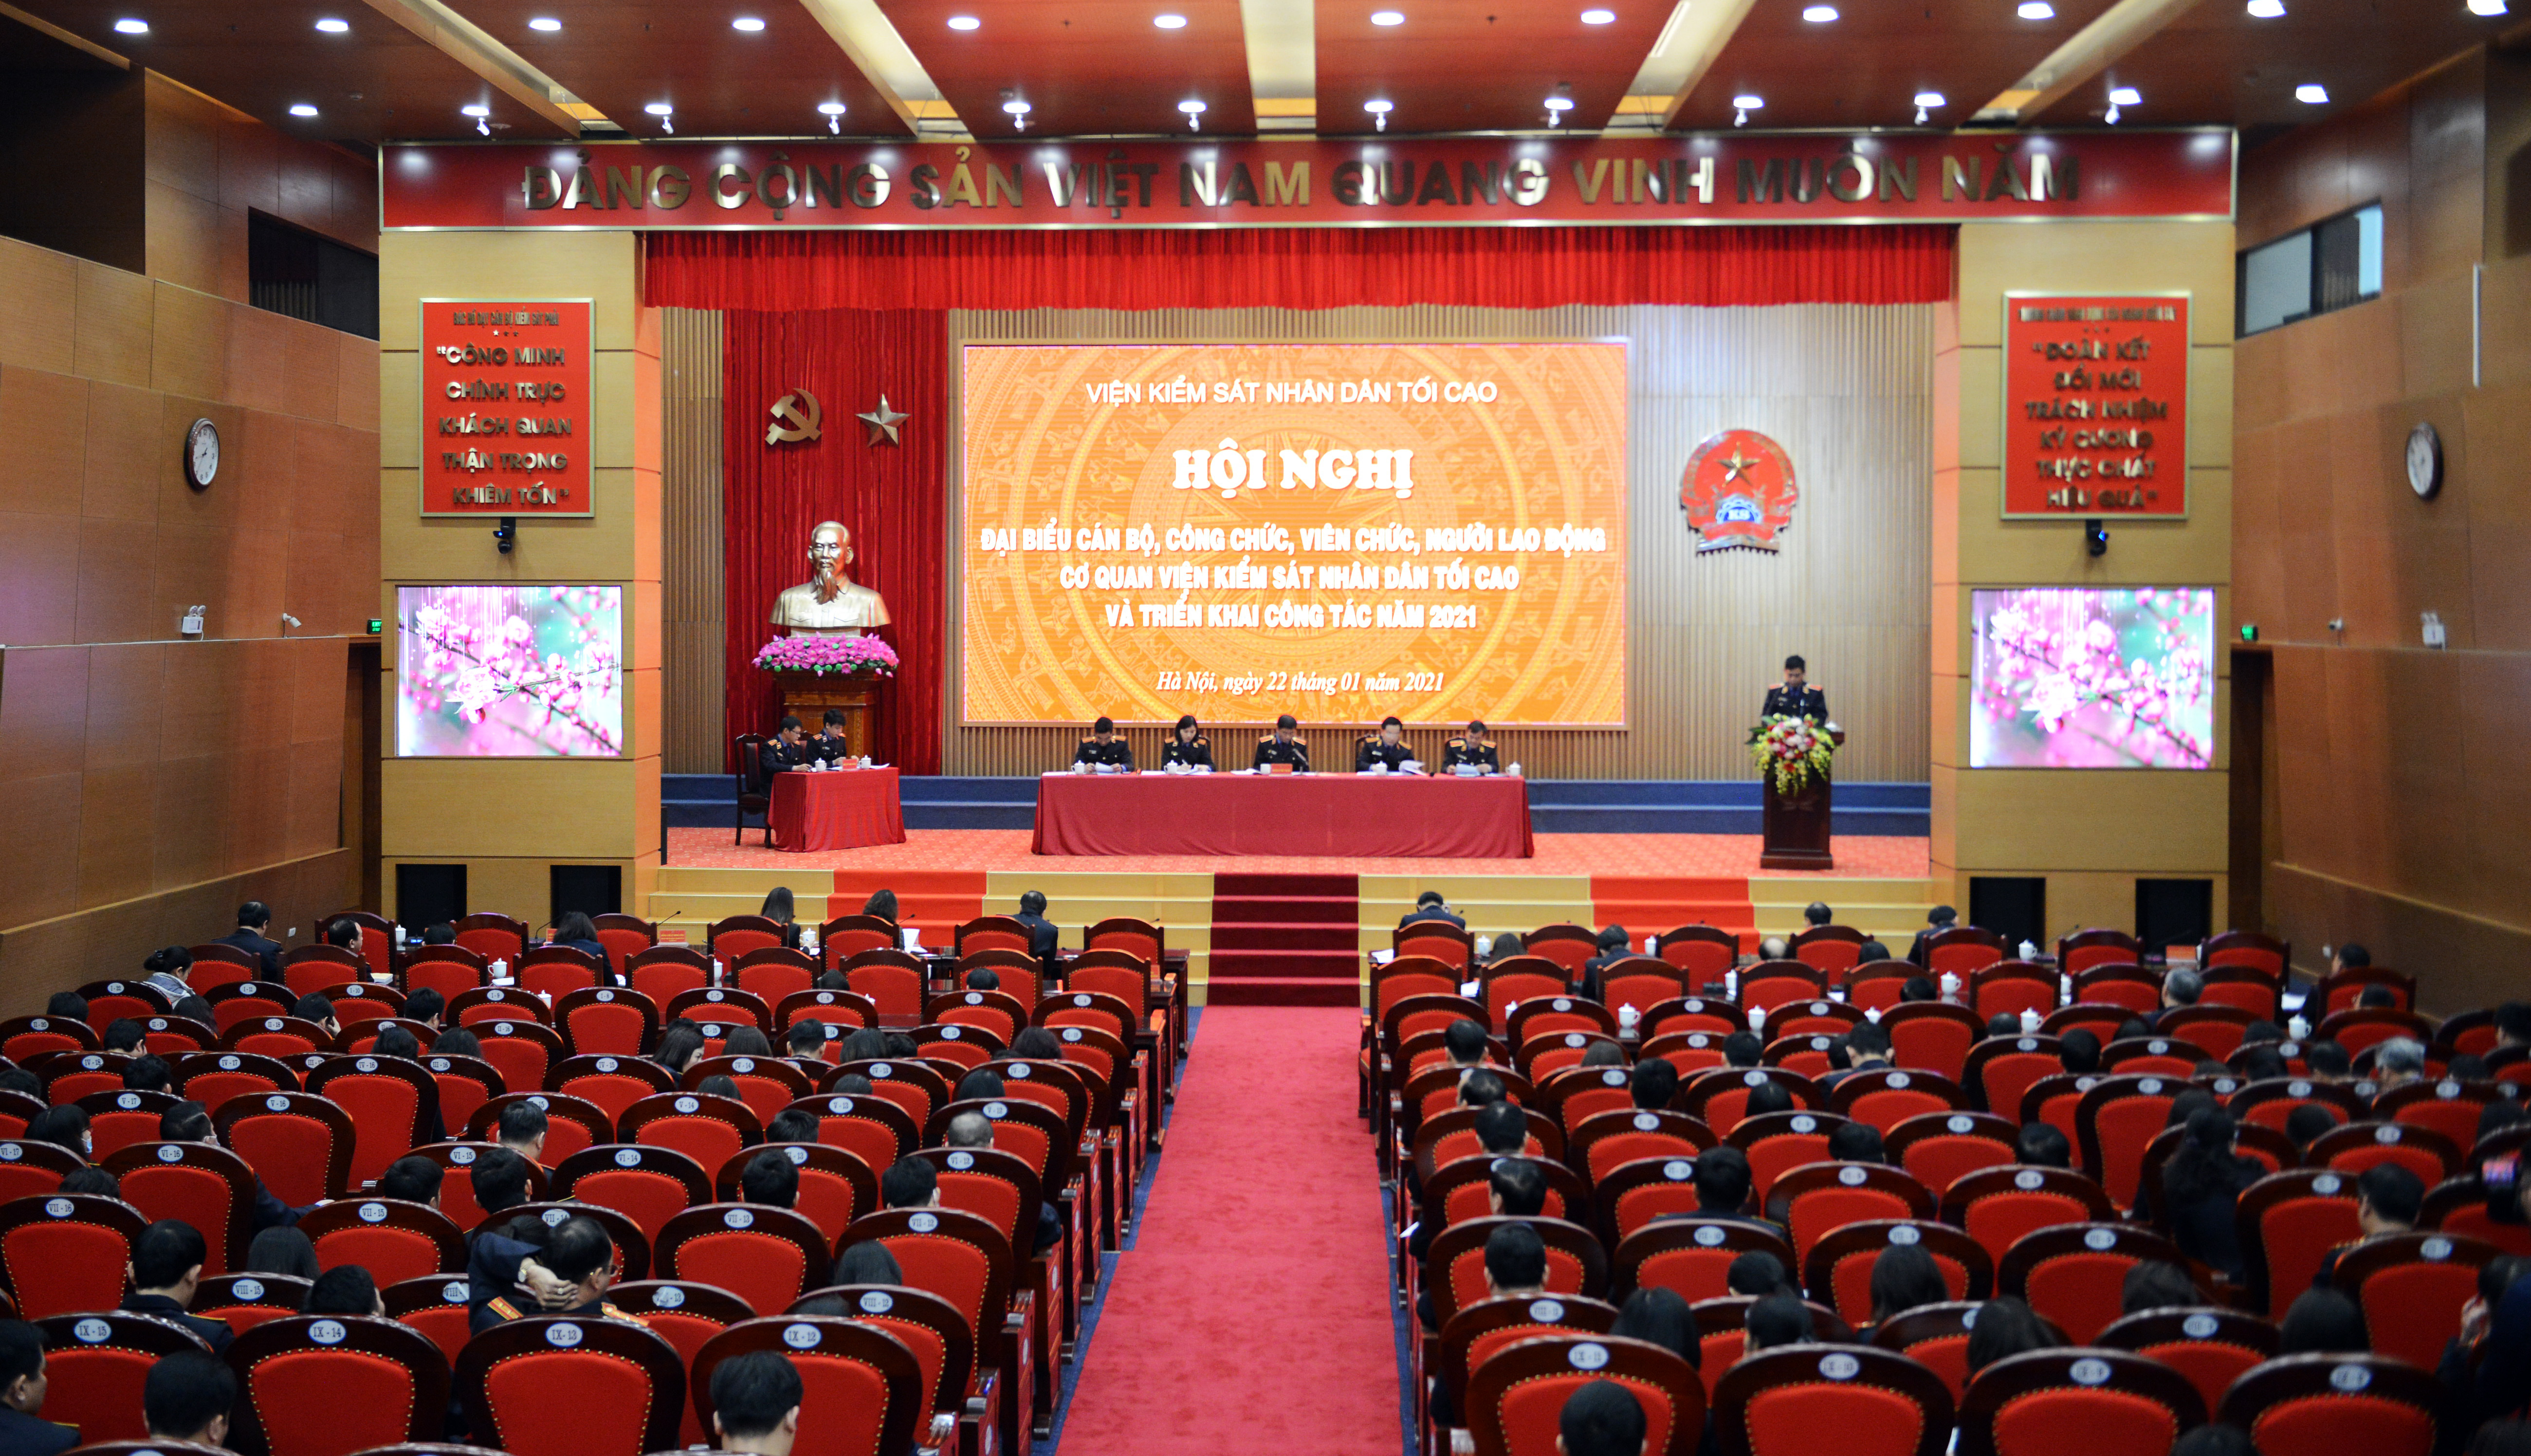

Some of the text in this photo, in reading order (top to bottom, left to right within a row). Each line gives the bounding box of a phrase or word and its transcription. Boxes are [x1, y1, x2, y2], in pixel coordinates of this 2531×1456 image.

[522, 141, 2079, 220] ĐẢNG CỘNG SẢN VIỆT NAM QUANG VINH MUÔN NĂM
[445, 378, 565, 404] CHÍNH TRỰC
[1086, 375, 1498, 407] VIỆN KIỂM SÁT NHÂN DÂN TỐI CAO
[439, 412, 571, 436] KHÁCH QUAN
[442, 447, 568, 474] THẬN TRỌNG
[1172, 437, 1413, 498] HỘI NGHỊ
[980, 517, 1606, 558] ĐẠI BIỂU CÁN BỘ, CÔNG CHỨC, VIÊN CHỨC, NGƯỜI LAO ĐỘNG
[1060, 556, 1520, 595] CƠ QUAN VIỆN KIỂM SÁT NHÂN DÂN TỐI CAO
[1105, 594, 1476, 629] VÀ TRIỂN KHAI CÔNG TÁC NĂM 2021
[1156, 671, 1444, 696] Hà Nội, ngày 22 tháng 01 năm 2021
